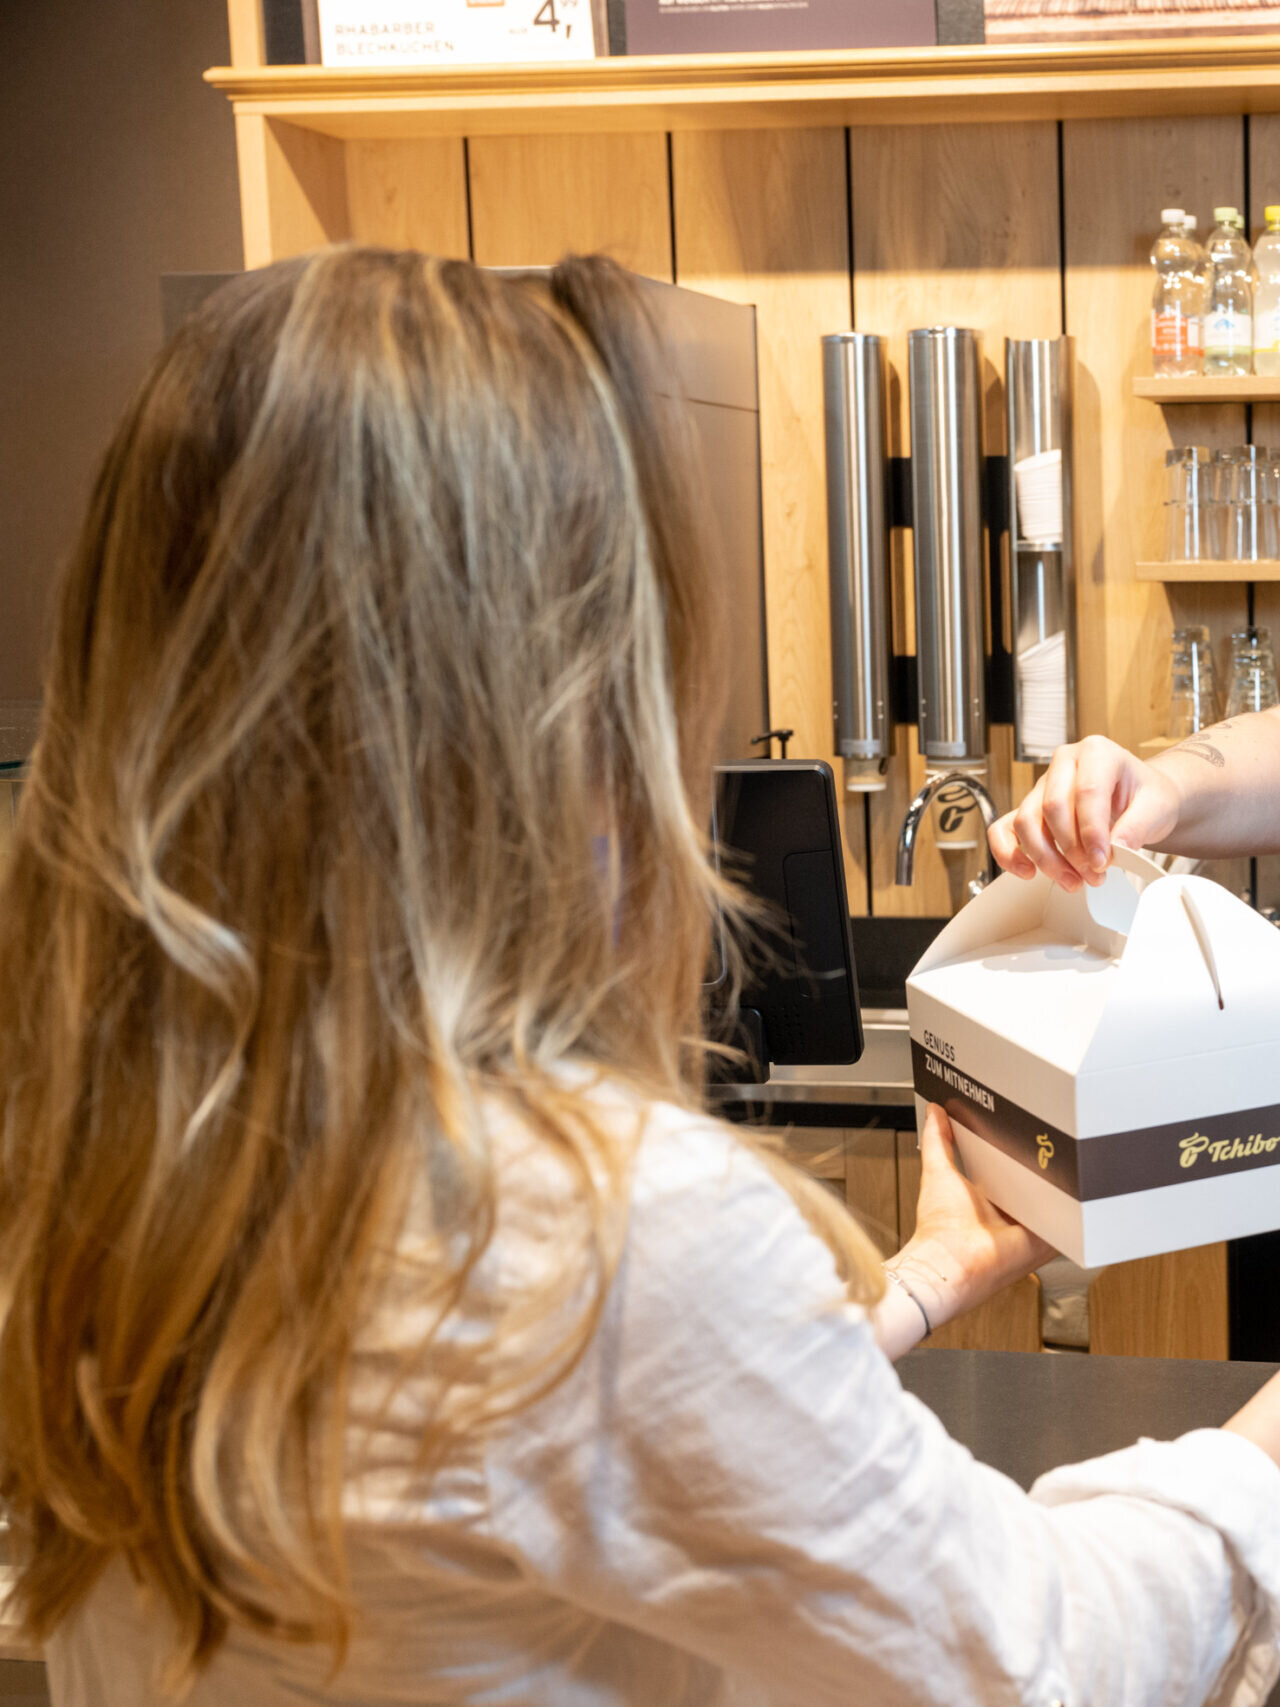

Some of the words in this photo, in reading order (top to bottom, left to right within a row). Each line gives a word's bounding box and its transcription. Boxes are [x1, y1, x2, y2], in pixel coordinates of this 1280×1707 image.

[923, 1029, 955, 1062] GENUSS
[925, 1053, 943, 1079] ZUM
[943, 1065, 995, 1112] MITNEHMEN
